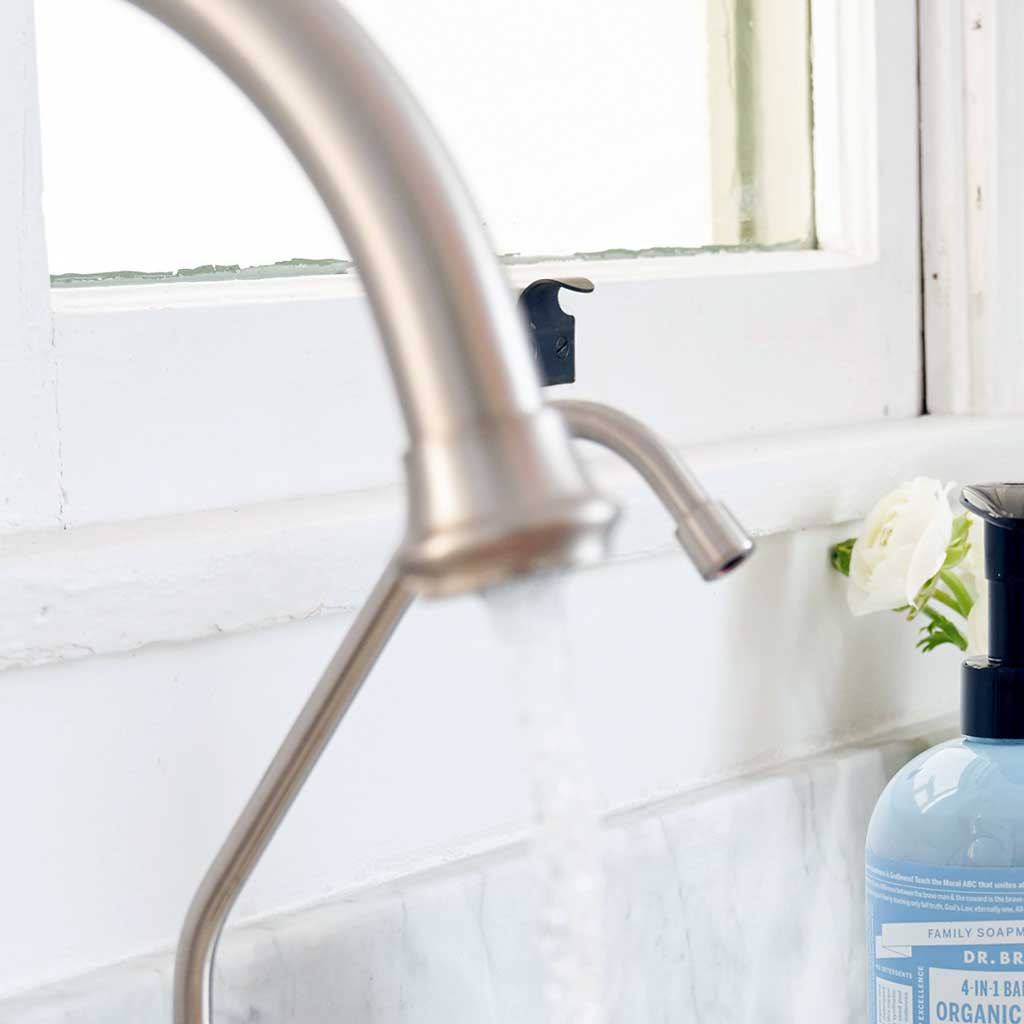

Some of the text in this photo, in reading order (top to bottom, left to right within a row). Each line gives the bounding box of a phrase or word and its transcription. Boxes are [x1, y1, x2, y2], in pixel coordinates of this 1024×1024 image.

[962, 879, 977, 888] ABC
[928, 928, 972, 939] FAMILY
[963, 950, 996, 965] DR.
[961, 979, 1000, 997] 4-IN-1
[936, 1000, 1022, 1024] ORGANIC
